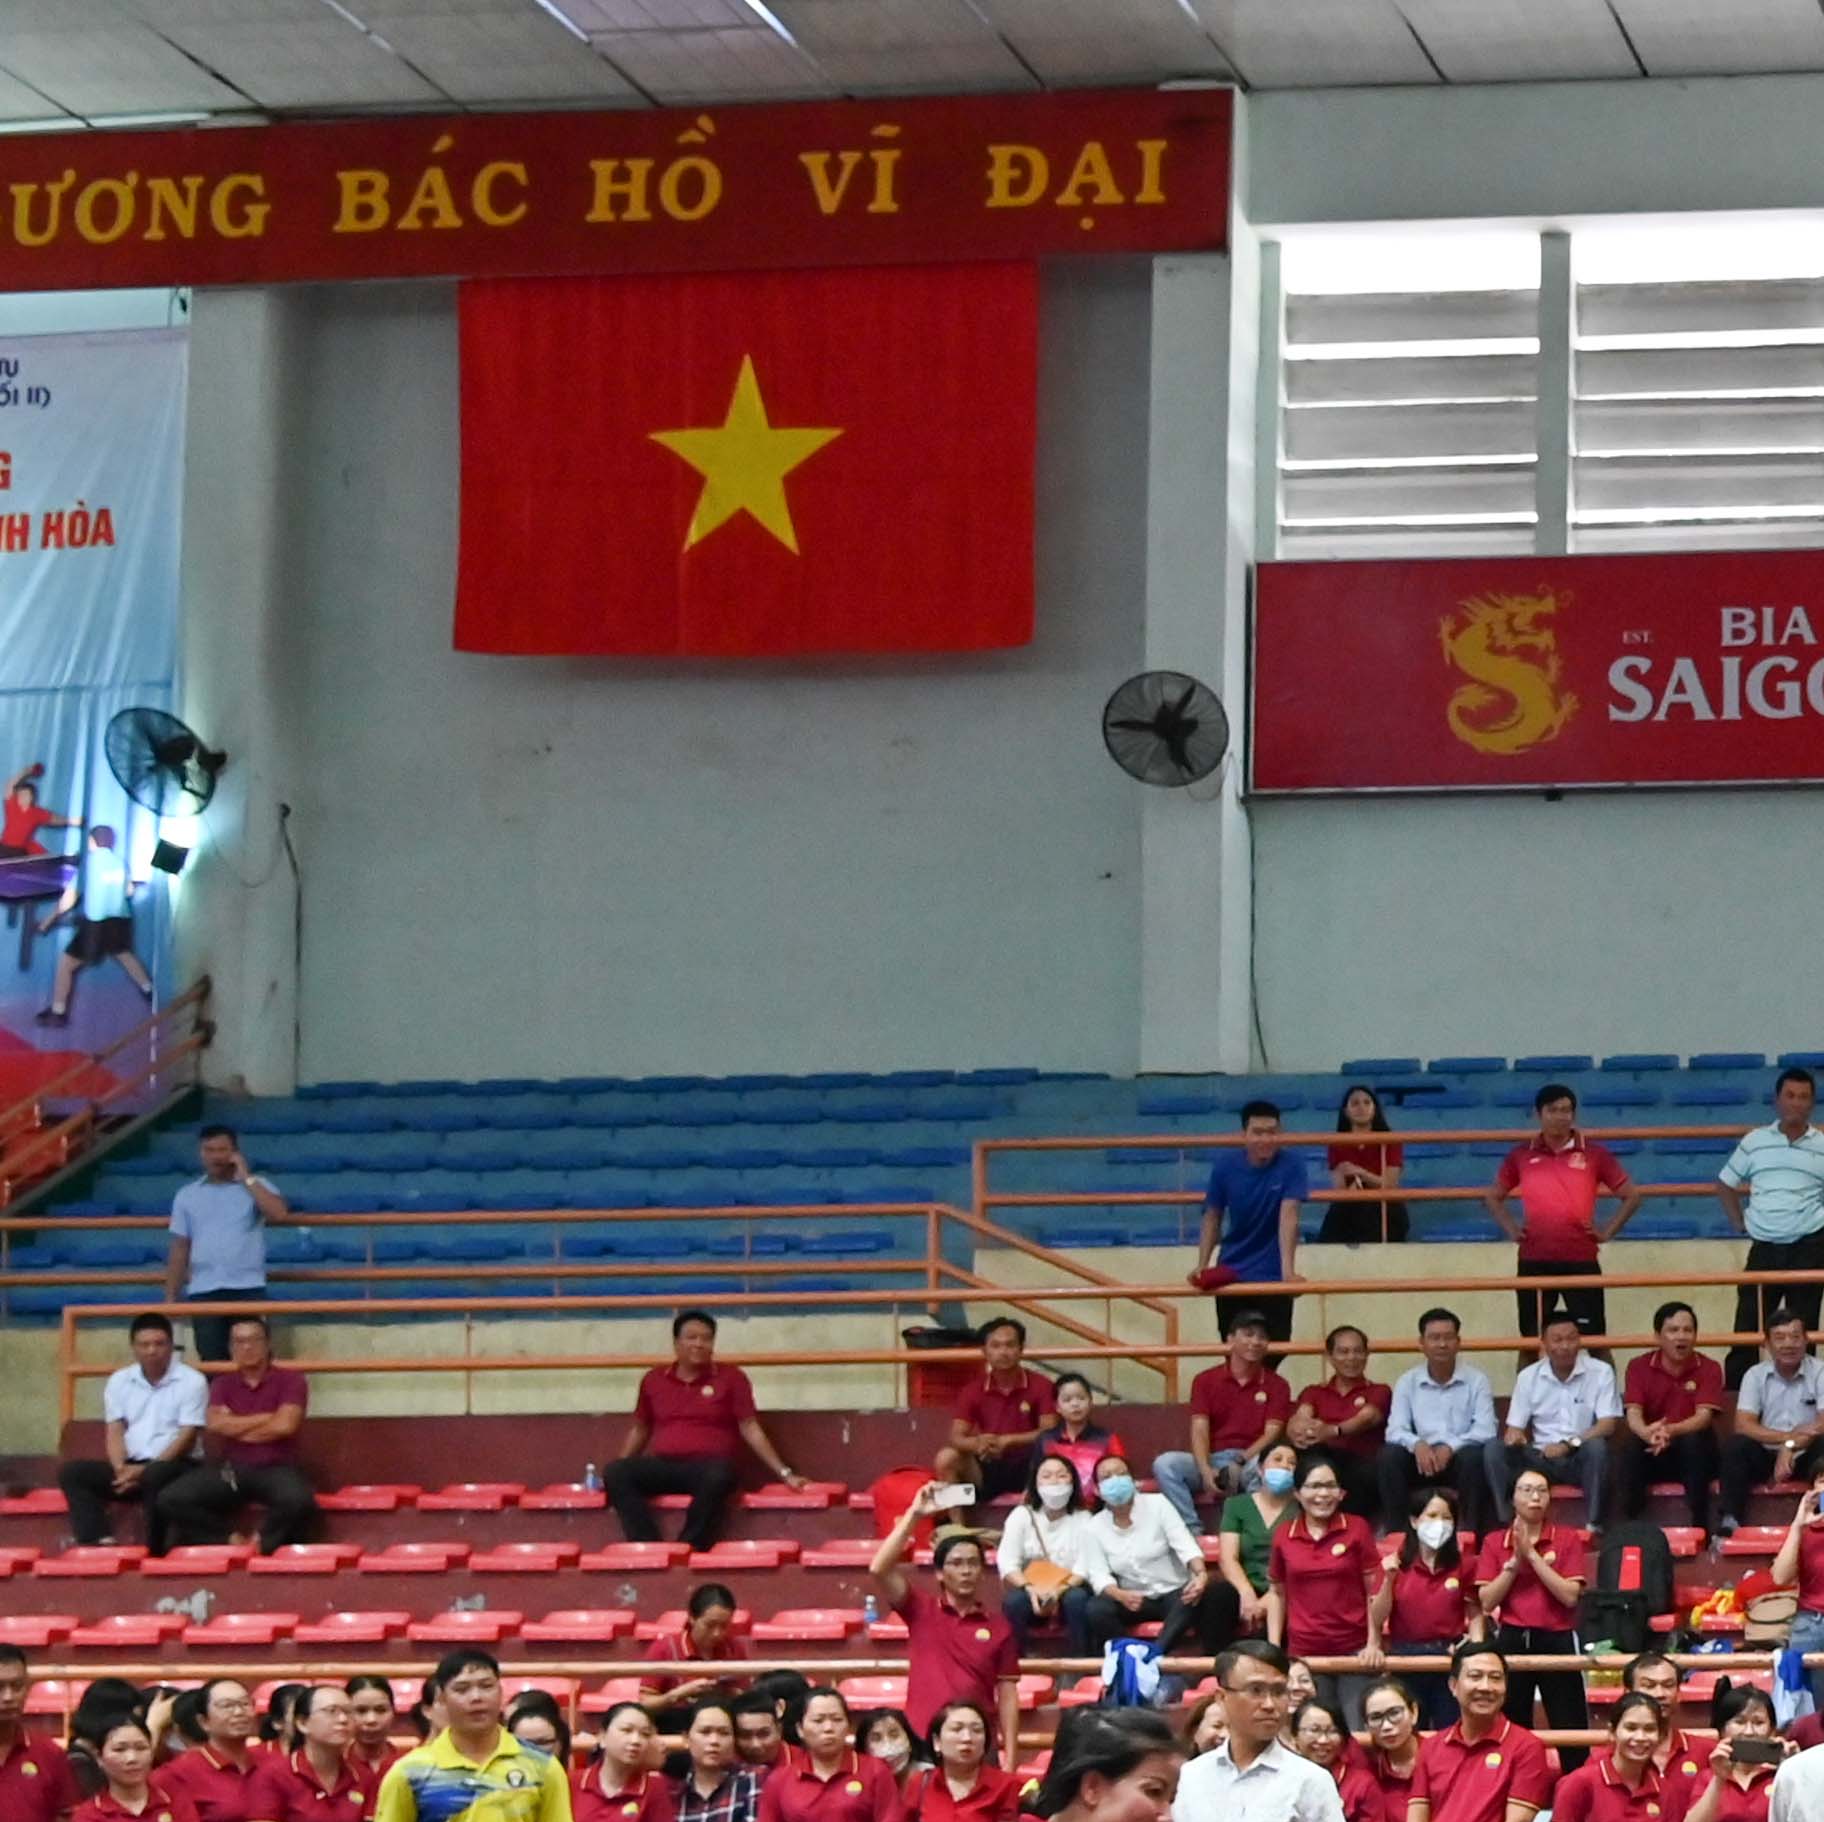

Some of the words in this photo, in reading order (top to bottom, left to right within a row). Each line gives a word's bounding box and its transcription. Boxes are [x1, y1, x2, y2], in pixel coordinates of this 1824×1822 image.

[0, 168, 271, 246] ƯƠNG
[333, 135, 529, 233] BÁC
[585, 115, 722, 222] HỒ
[800, 124, 901, 215] VĨ
[986, 140, 1168, 230] ĐẠI
[41, 500, 115, 549] HÒA
[1720, 606, 1818, 647] BIA
